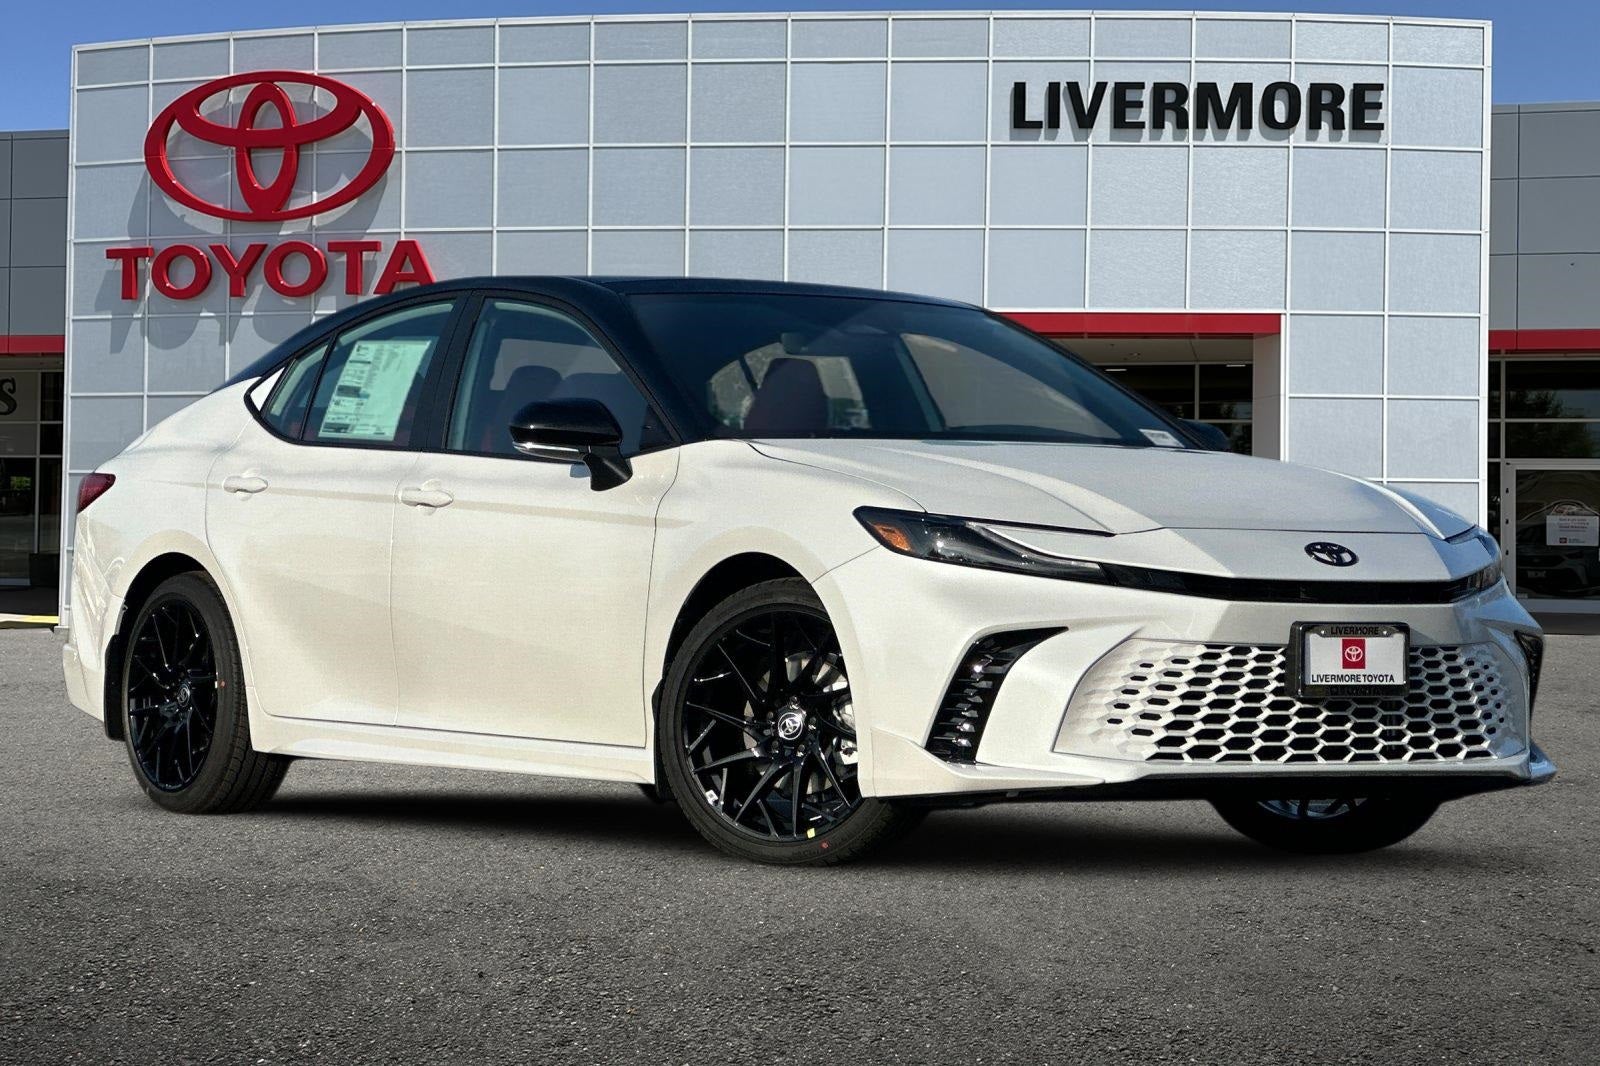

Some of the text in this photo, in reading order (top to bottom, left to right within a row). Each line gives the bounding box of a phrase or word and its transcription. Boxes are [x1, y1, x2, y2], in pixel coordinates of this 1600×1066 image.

[1012, 82, 1384, 131] LIVERMORE
[106, 240, 435, 300] TOYOTA
[1331, 626, 1379, 635] LIVERMORE
[1311, 674, 1395, 683] LIVERMORE TOYOTA
